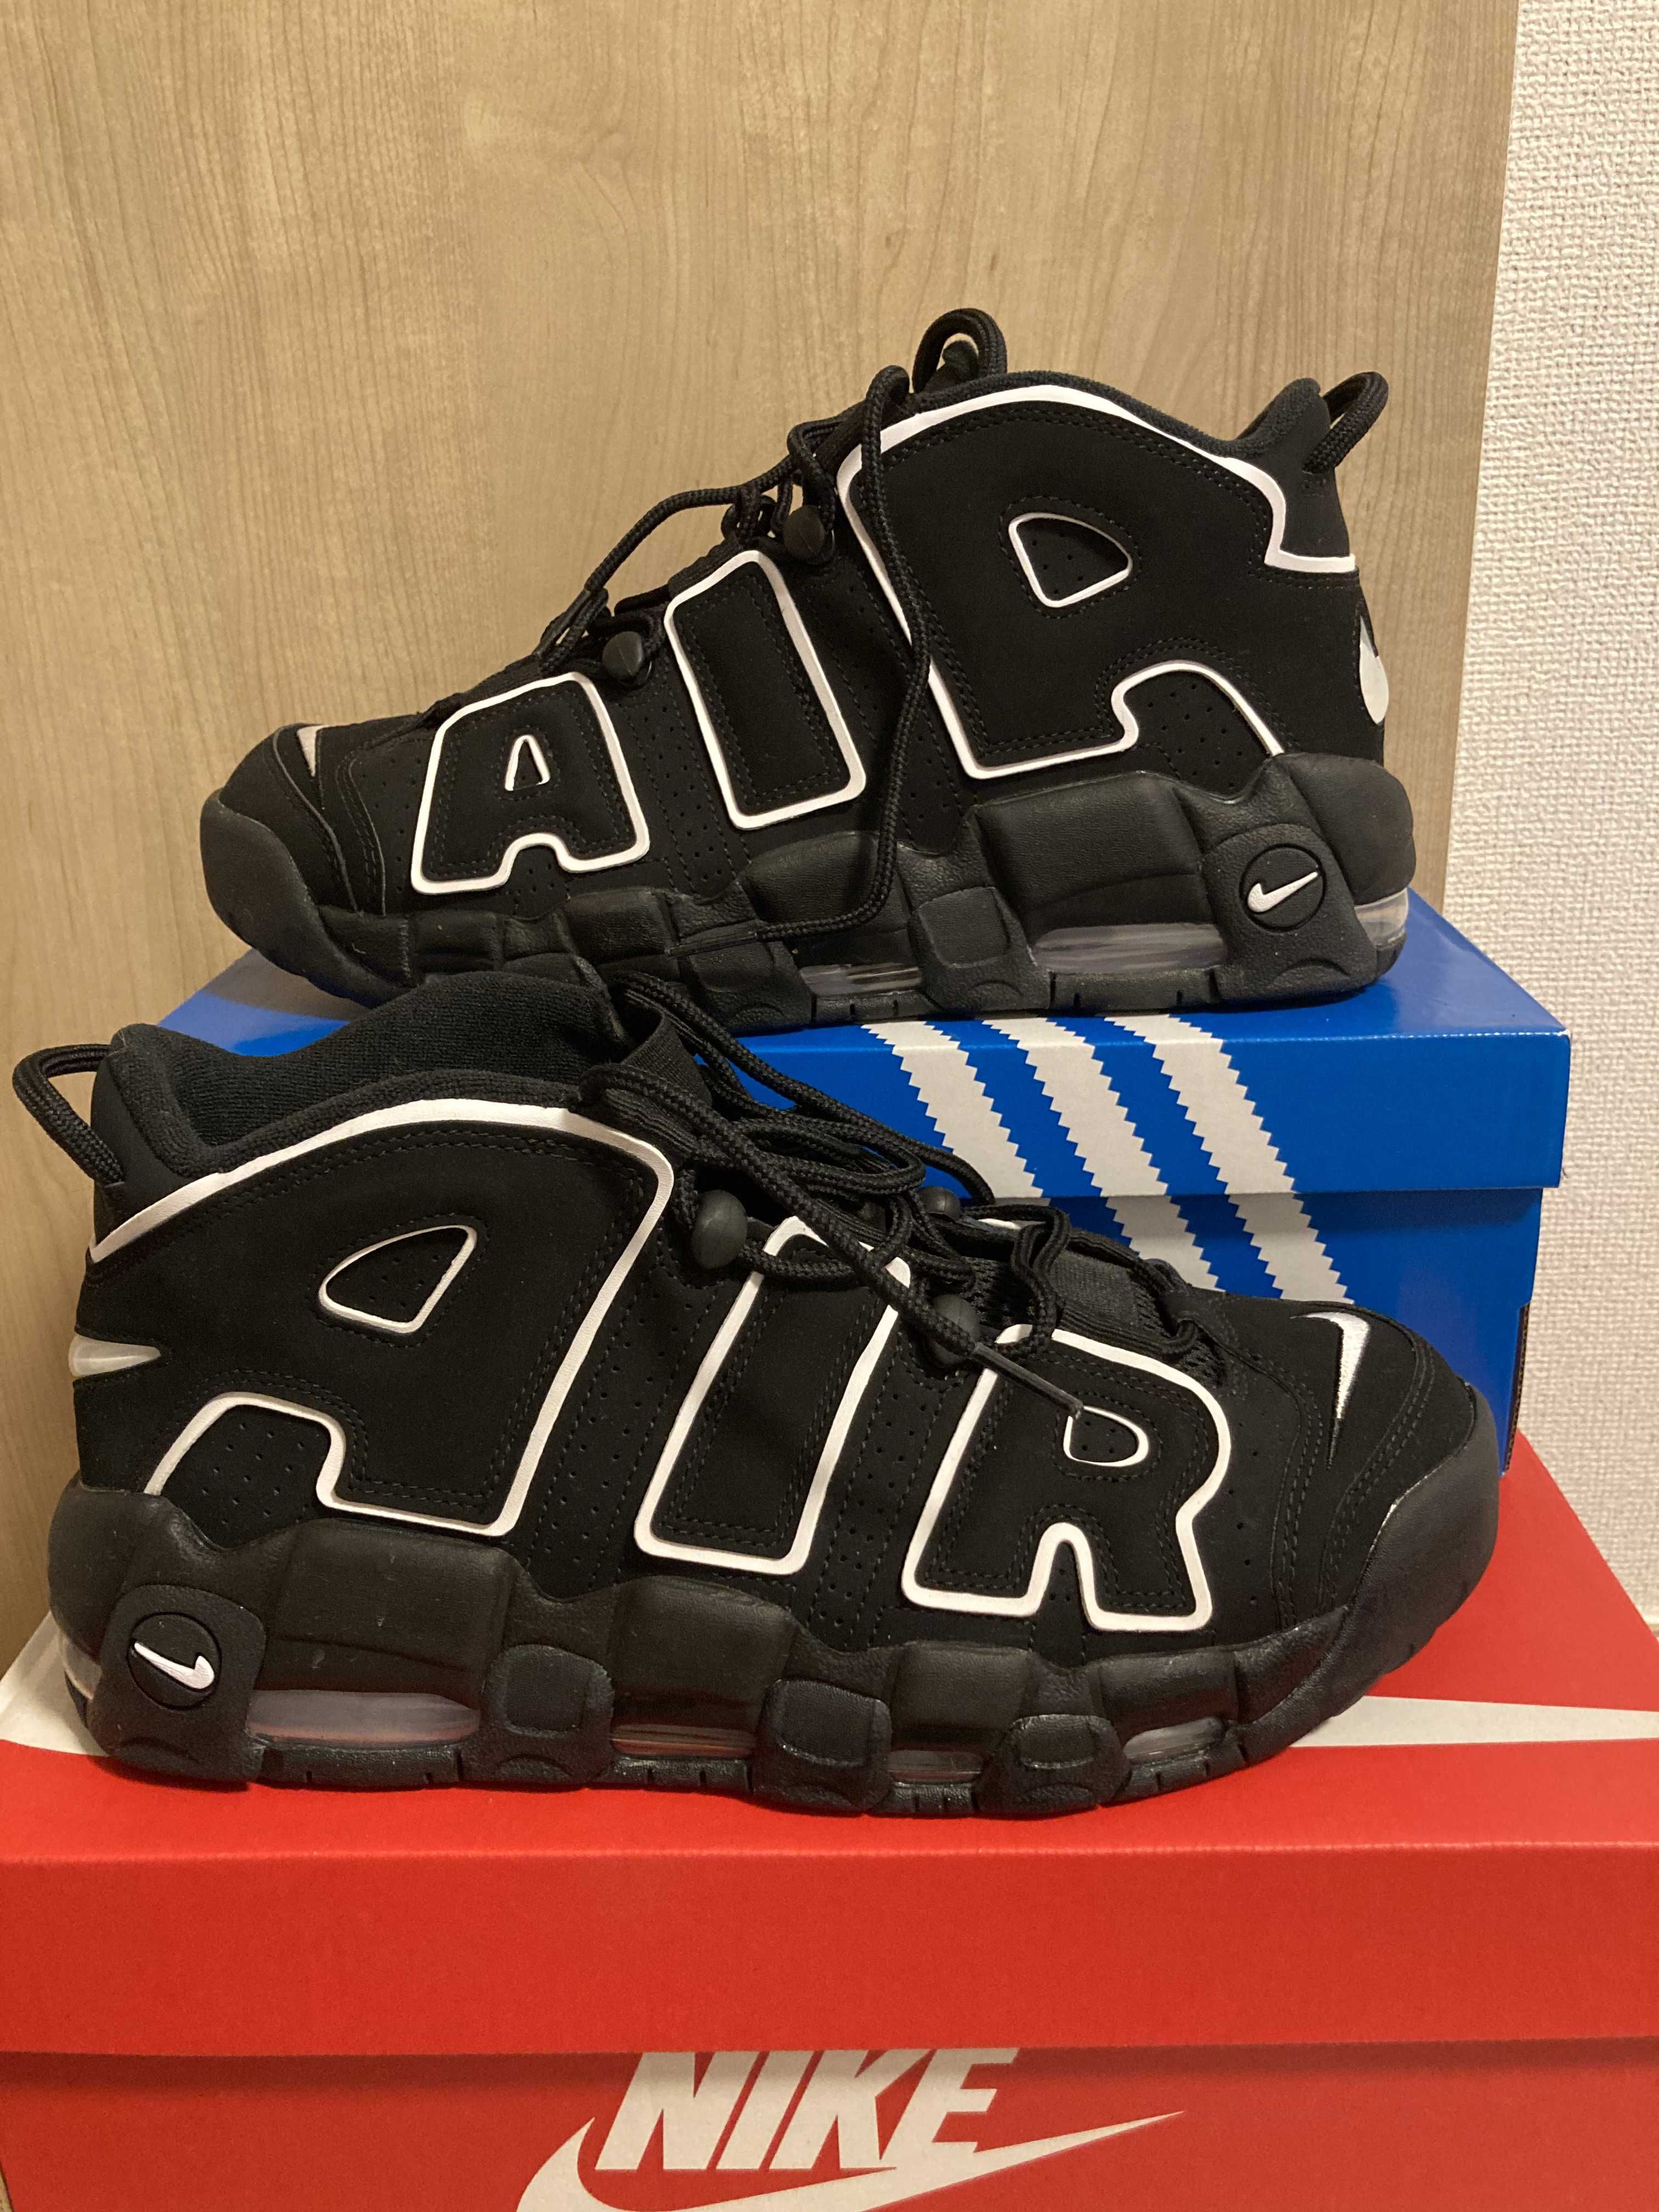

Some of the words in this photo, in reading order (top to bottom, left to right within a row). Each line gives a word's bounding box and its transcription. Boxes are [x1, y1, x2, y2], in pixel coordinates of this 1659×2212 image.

[411, 385, 1355, 894] AIR
[88, 1098, 1232, 1630] AIR
[594, 2047, 1020, 2170] NIKE
